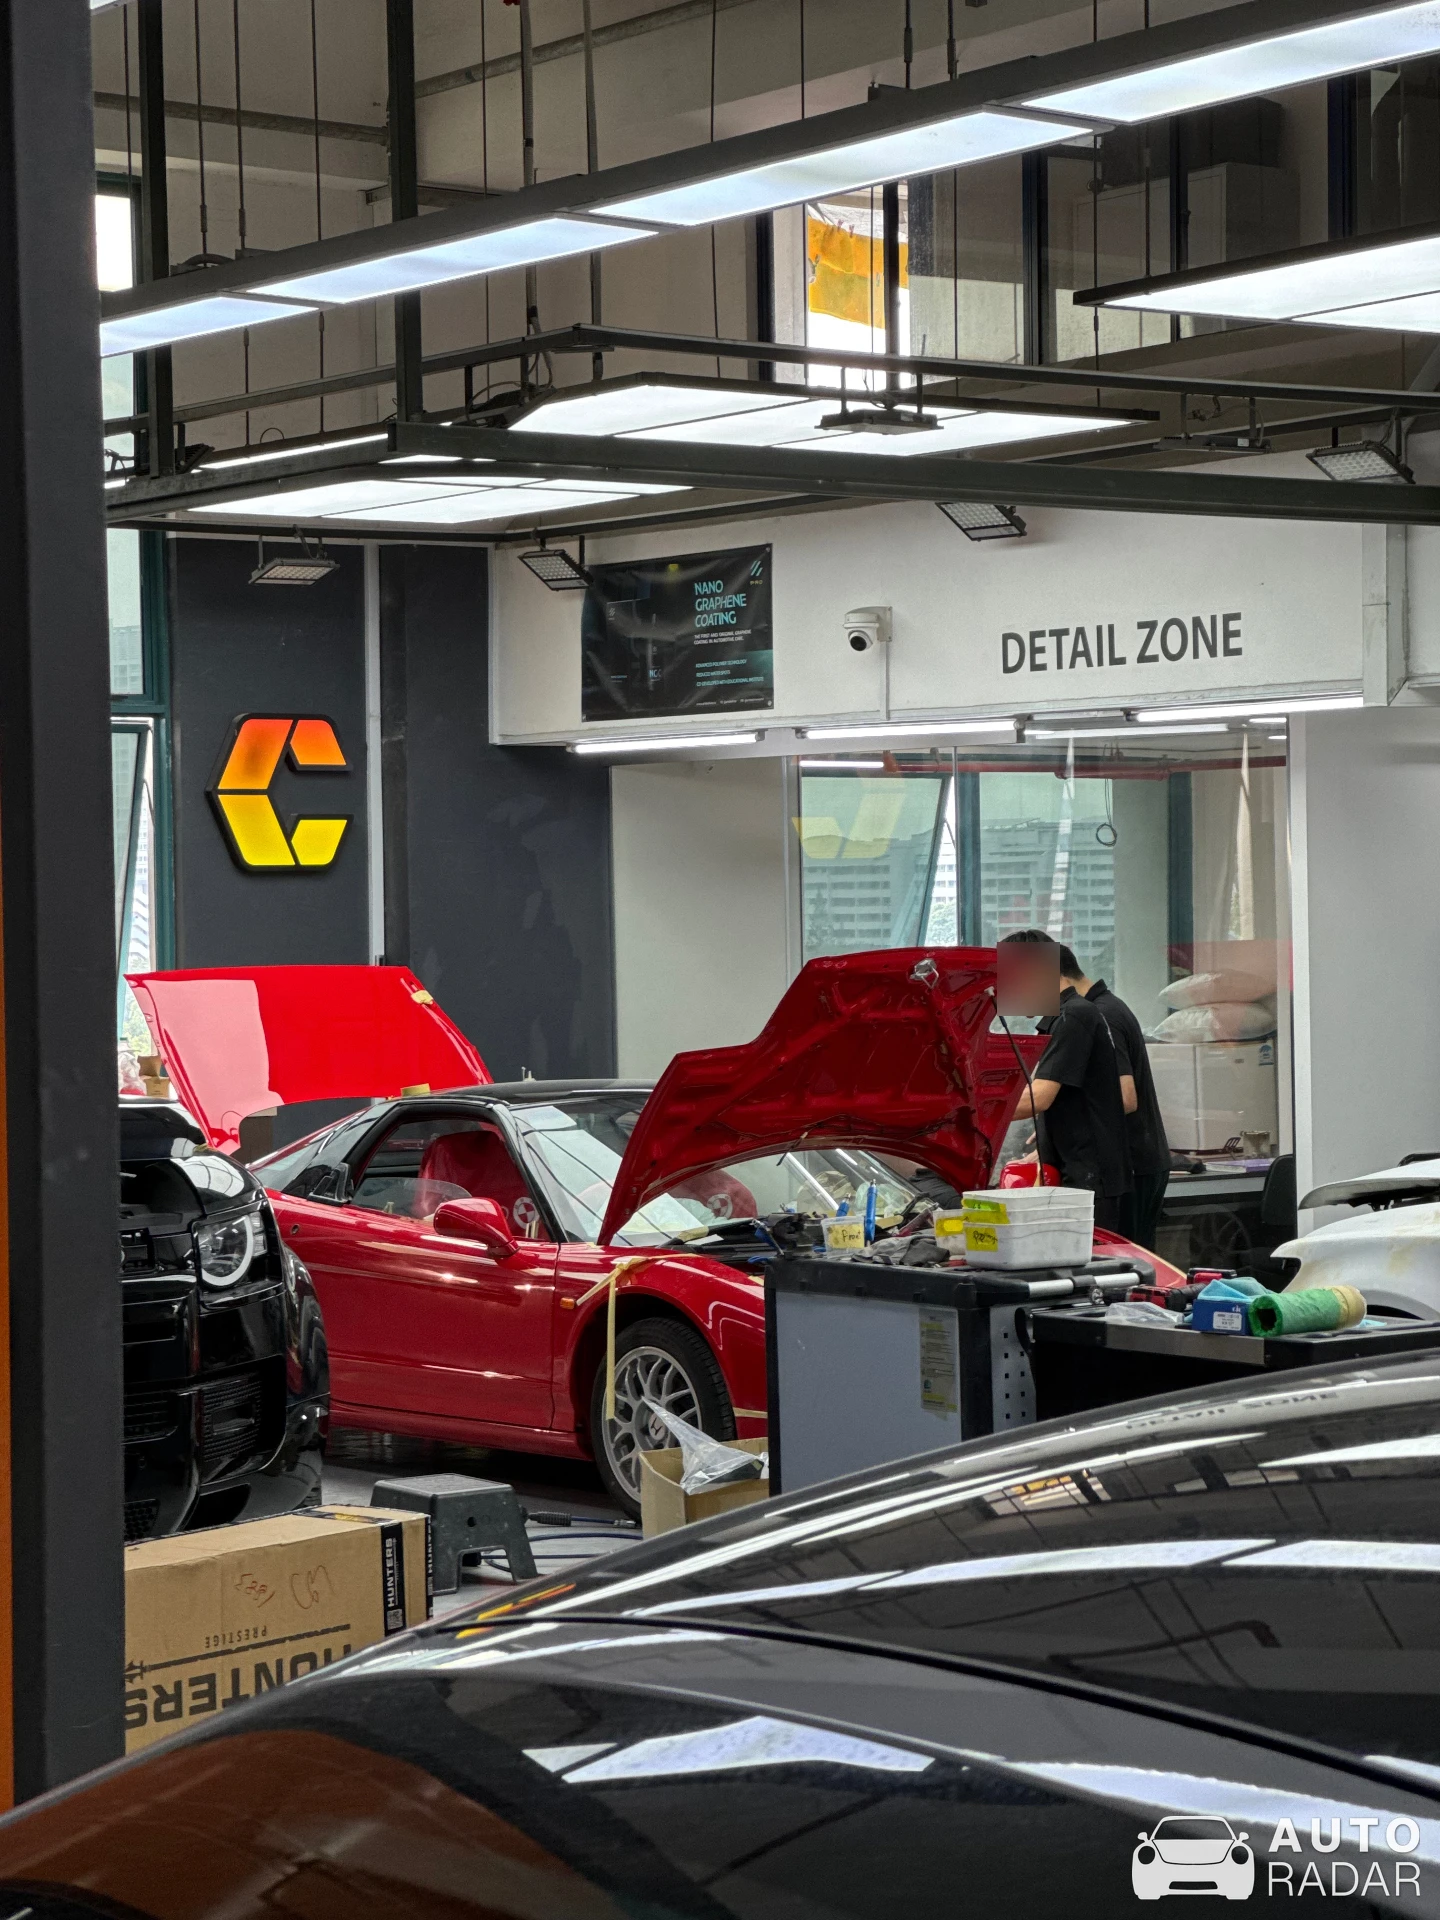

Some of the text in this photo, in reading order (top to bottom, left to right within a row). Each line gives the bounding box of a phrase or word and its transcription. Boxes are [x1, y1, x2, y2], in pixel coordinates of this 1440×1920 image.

[694, 580, 724, 595] NANO
[695, 593, 747, 612] GRAPHENE
[695, 610, 737, 627] COATING
[1001, 612, 1243, 674] DETAIL ZONE
[385, 1537, 395, 1607] HUNTERS
[204, 1625, 268, 1648] PRESTIGE
